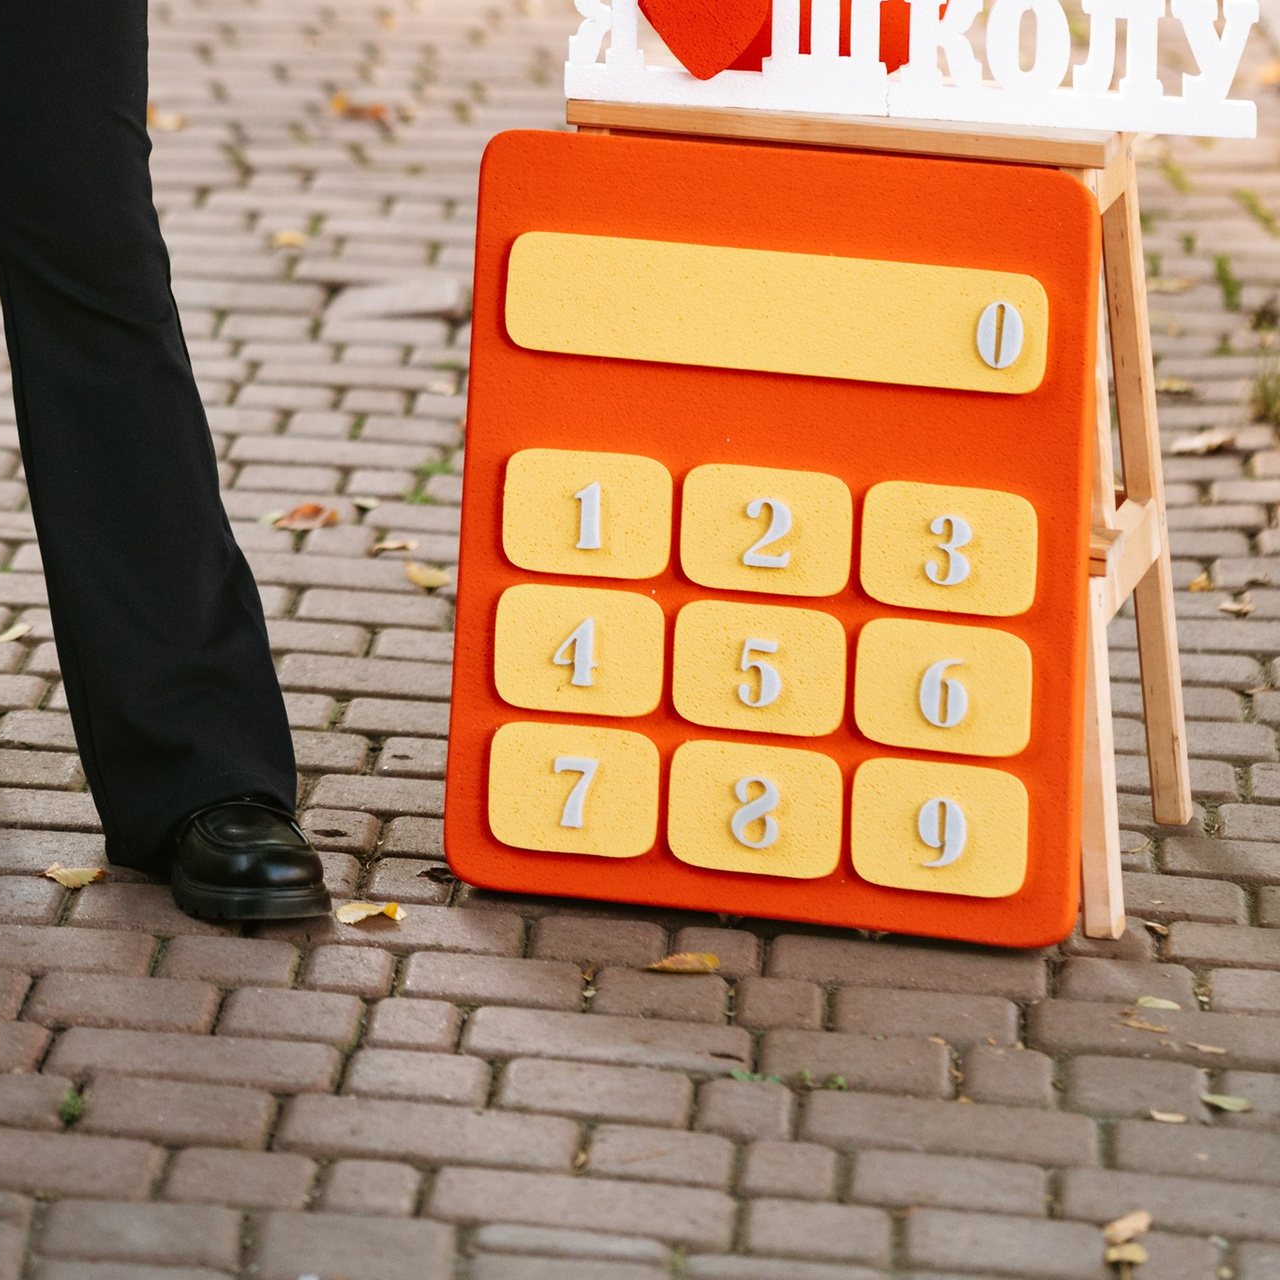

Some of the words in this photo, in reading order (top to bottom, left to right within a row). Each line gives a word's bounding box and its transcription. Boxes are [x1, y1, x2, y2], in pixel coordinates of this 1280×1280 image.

[976, 301, 1024, 370] 0
[574, 481, 602, 550] 1
[742, 498, 793, 569] 2
[925, 515, 973, 586] 3
[553, 618, 599, 687] 4
[737, 640, 782, 708] 5
[919, 659, 969, 729] 6
[553, 756, 598, 829] 7
[730, 775, 780, 850] 8
[917, 797, 968, 868] 9
